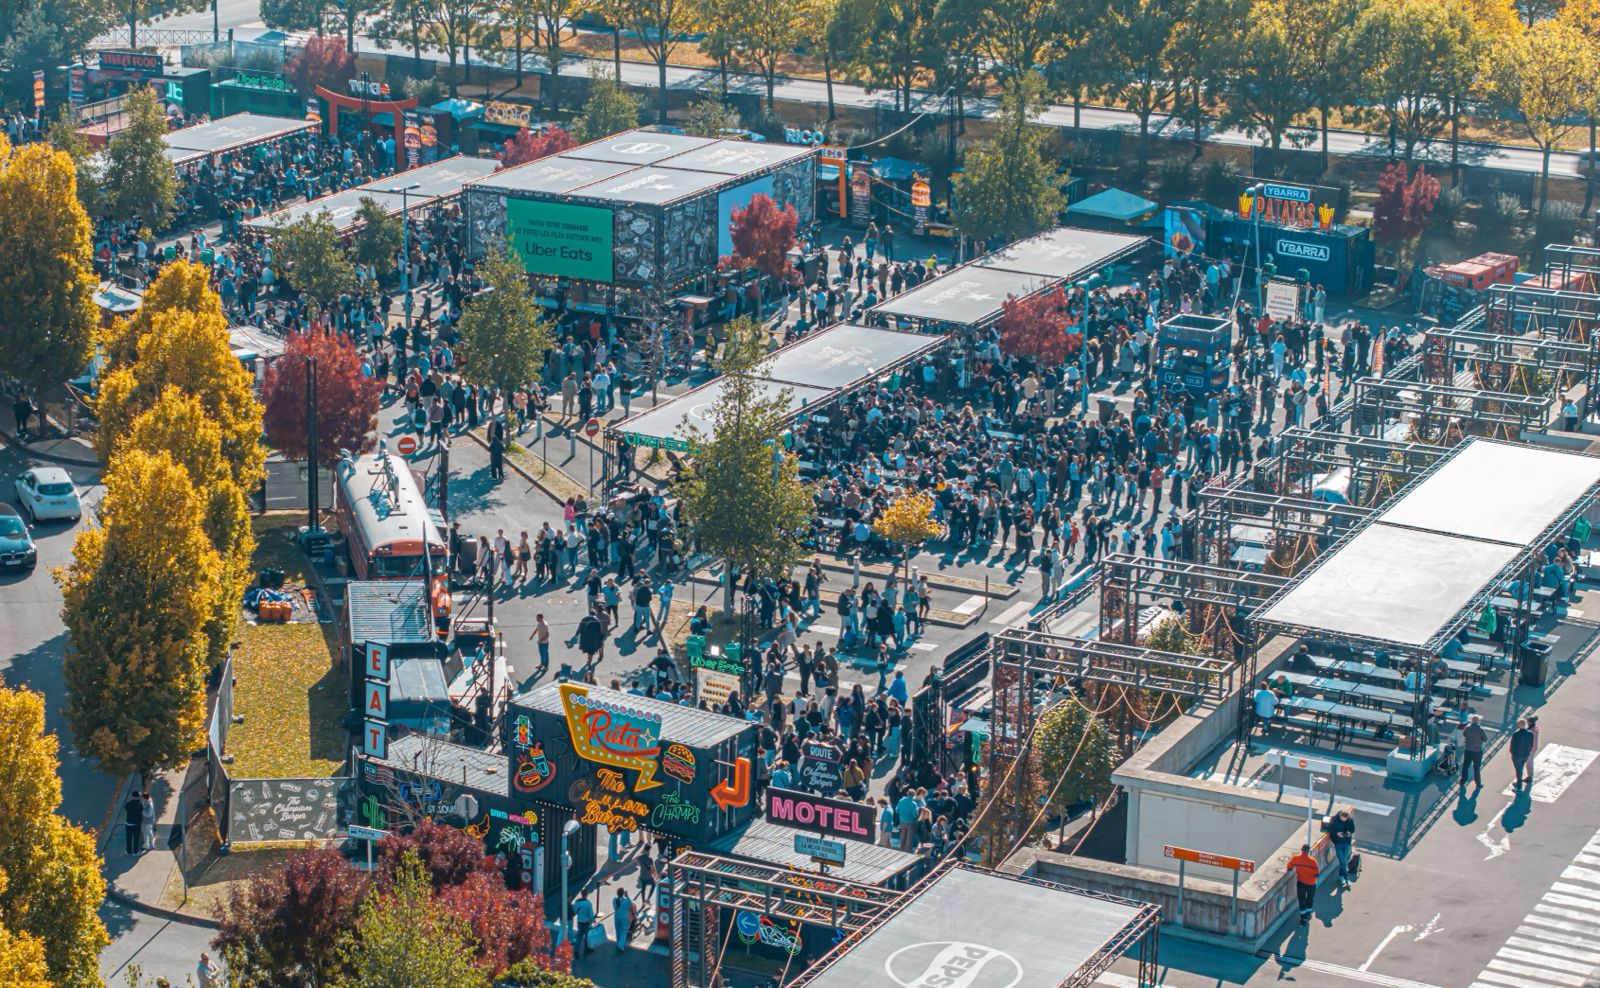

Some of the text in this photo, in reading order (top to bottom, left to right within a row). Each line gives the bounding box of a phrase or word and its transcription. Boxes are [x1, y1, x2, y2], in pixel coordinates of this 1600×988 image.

[785, 128, 824, 145] RICO
[1268, 187, 1306, 199] YBARRA
[1256, 196, 1316, 228] PATATAS
[525, 241, 593, 262] Uber Eats
[1281, 242, 1326, 258] YBARRA
[625, 430, 660, 448] Uber
[690, 656, 745, 675] Uber Eats
[369, 648, 383, 751] EAT
[583, 710, 654, 755] Ruta
[810, 746, 833, 760] ROUTE
[816, 761, 828, 772] The
[597, 768, 625, 793] The
[809, 776, 833, 788] Burger
[286, 796, 301, 807] The
[662, 790, 680, 804] The
[280, 812, 306, 823] Burger
[581, 801, 638, 834] Burger
[772, 796, 868, 836] MOTEL
